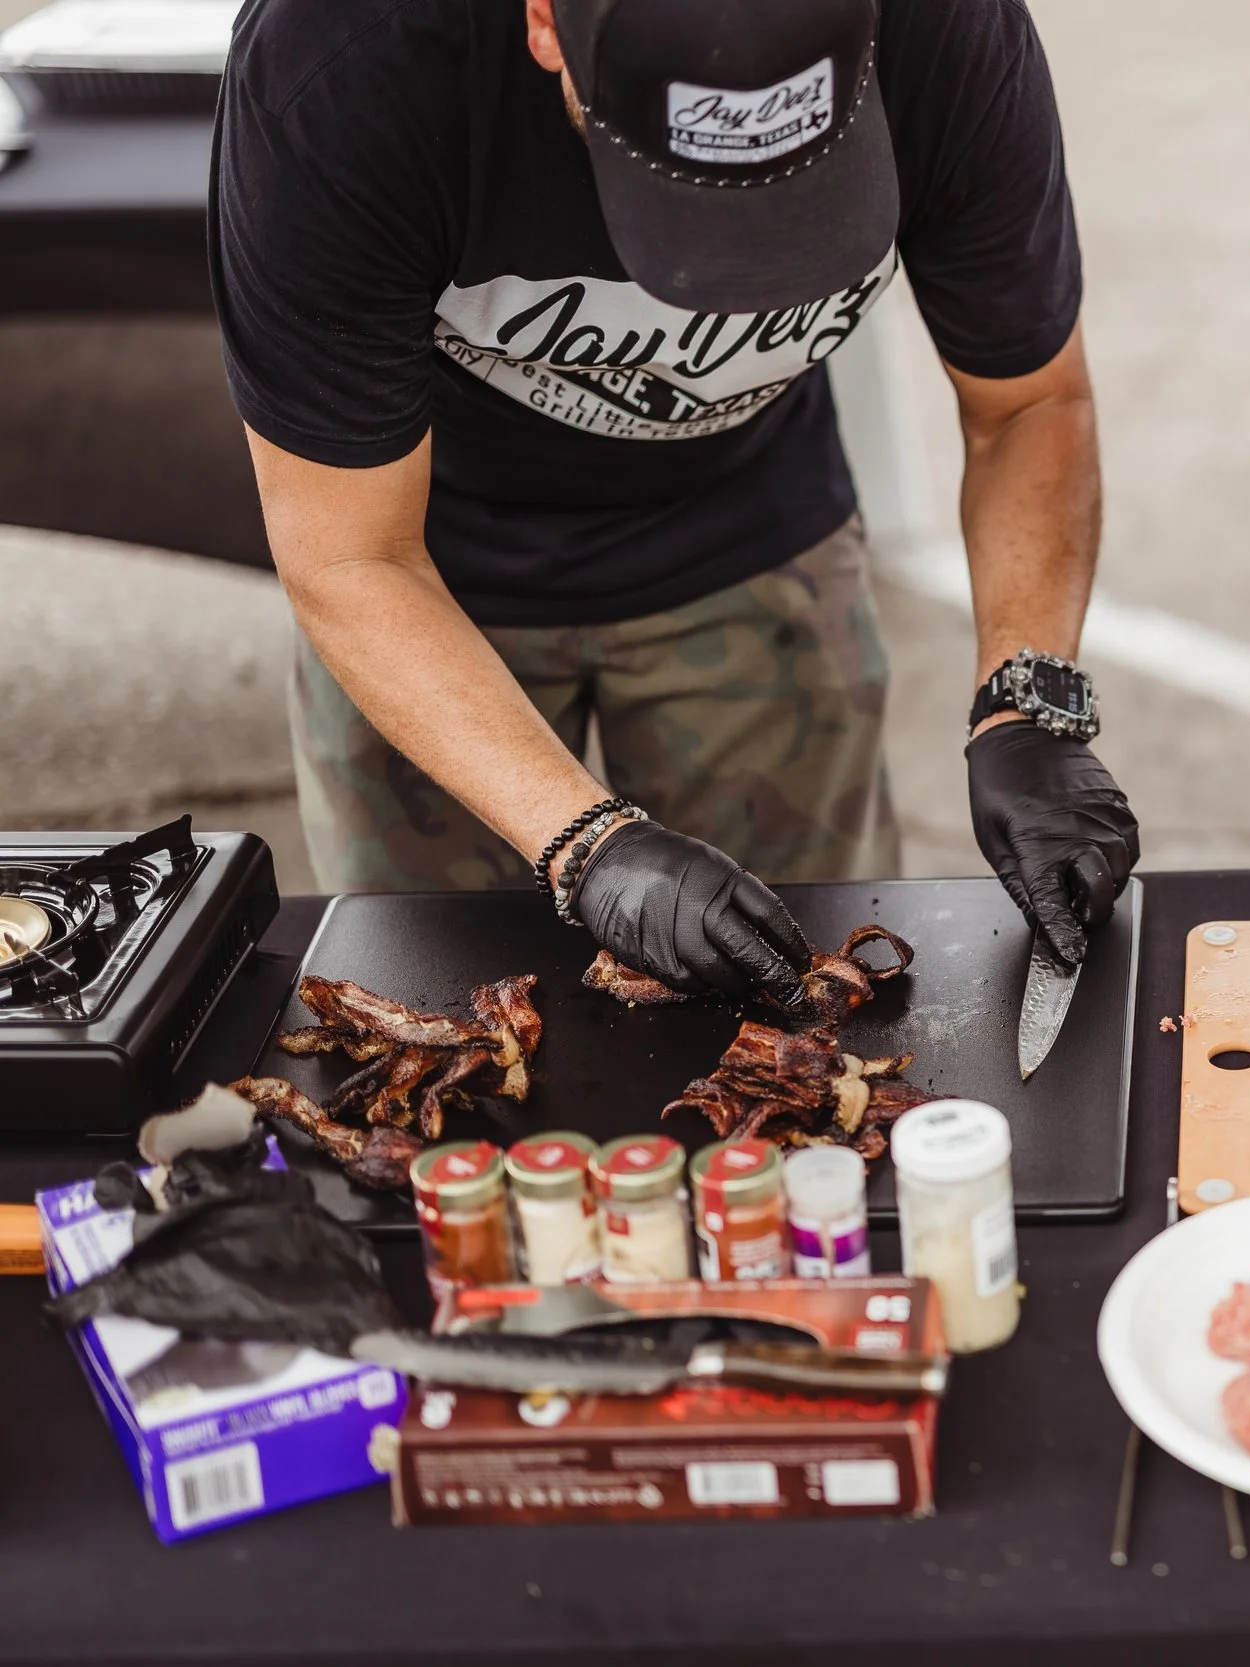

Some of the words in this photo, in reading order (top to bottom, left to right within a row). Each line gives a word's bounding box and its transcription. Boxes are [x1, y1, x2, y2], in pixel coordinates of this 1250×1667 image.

[675, 95, 752, 131] Jay
[501, 358, 566, 398] est
[529, 389, 596, 428] Grill
